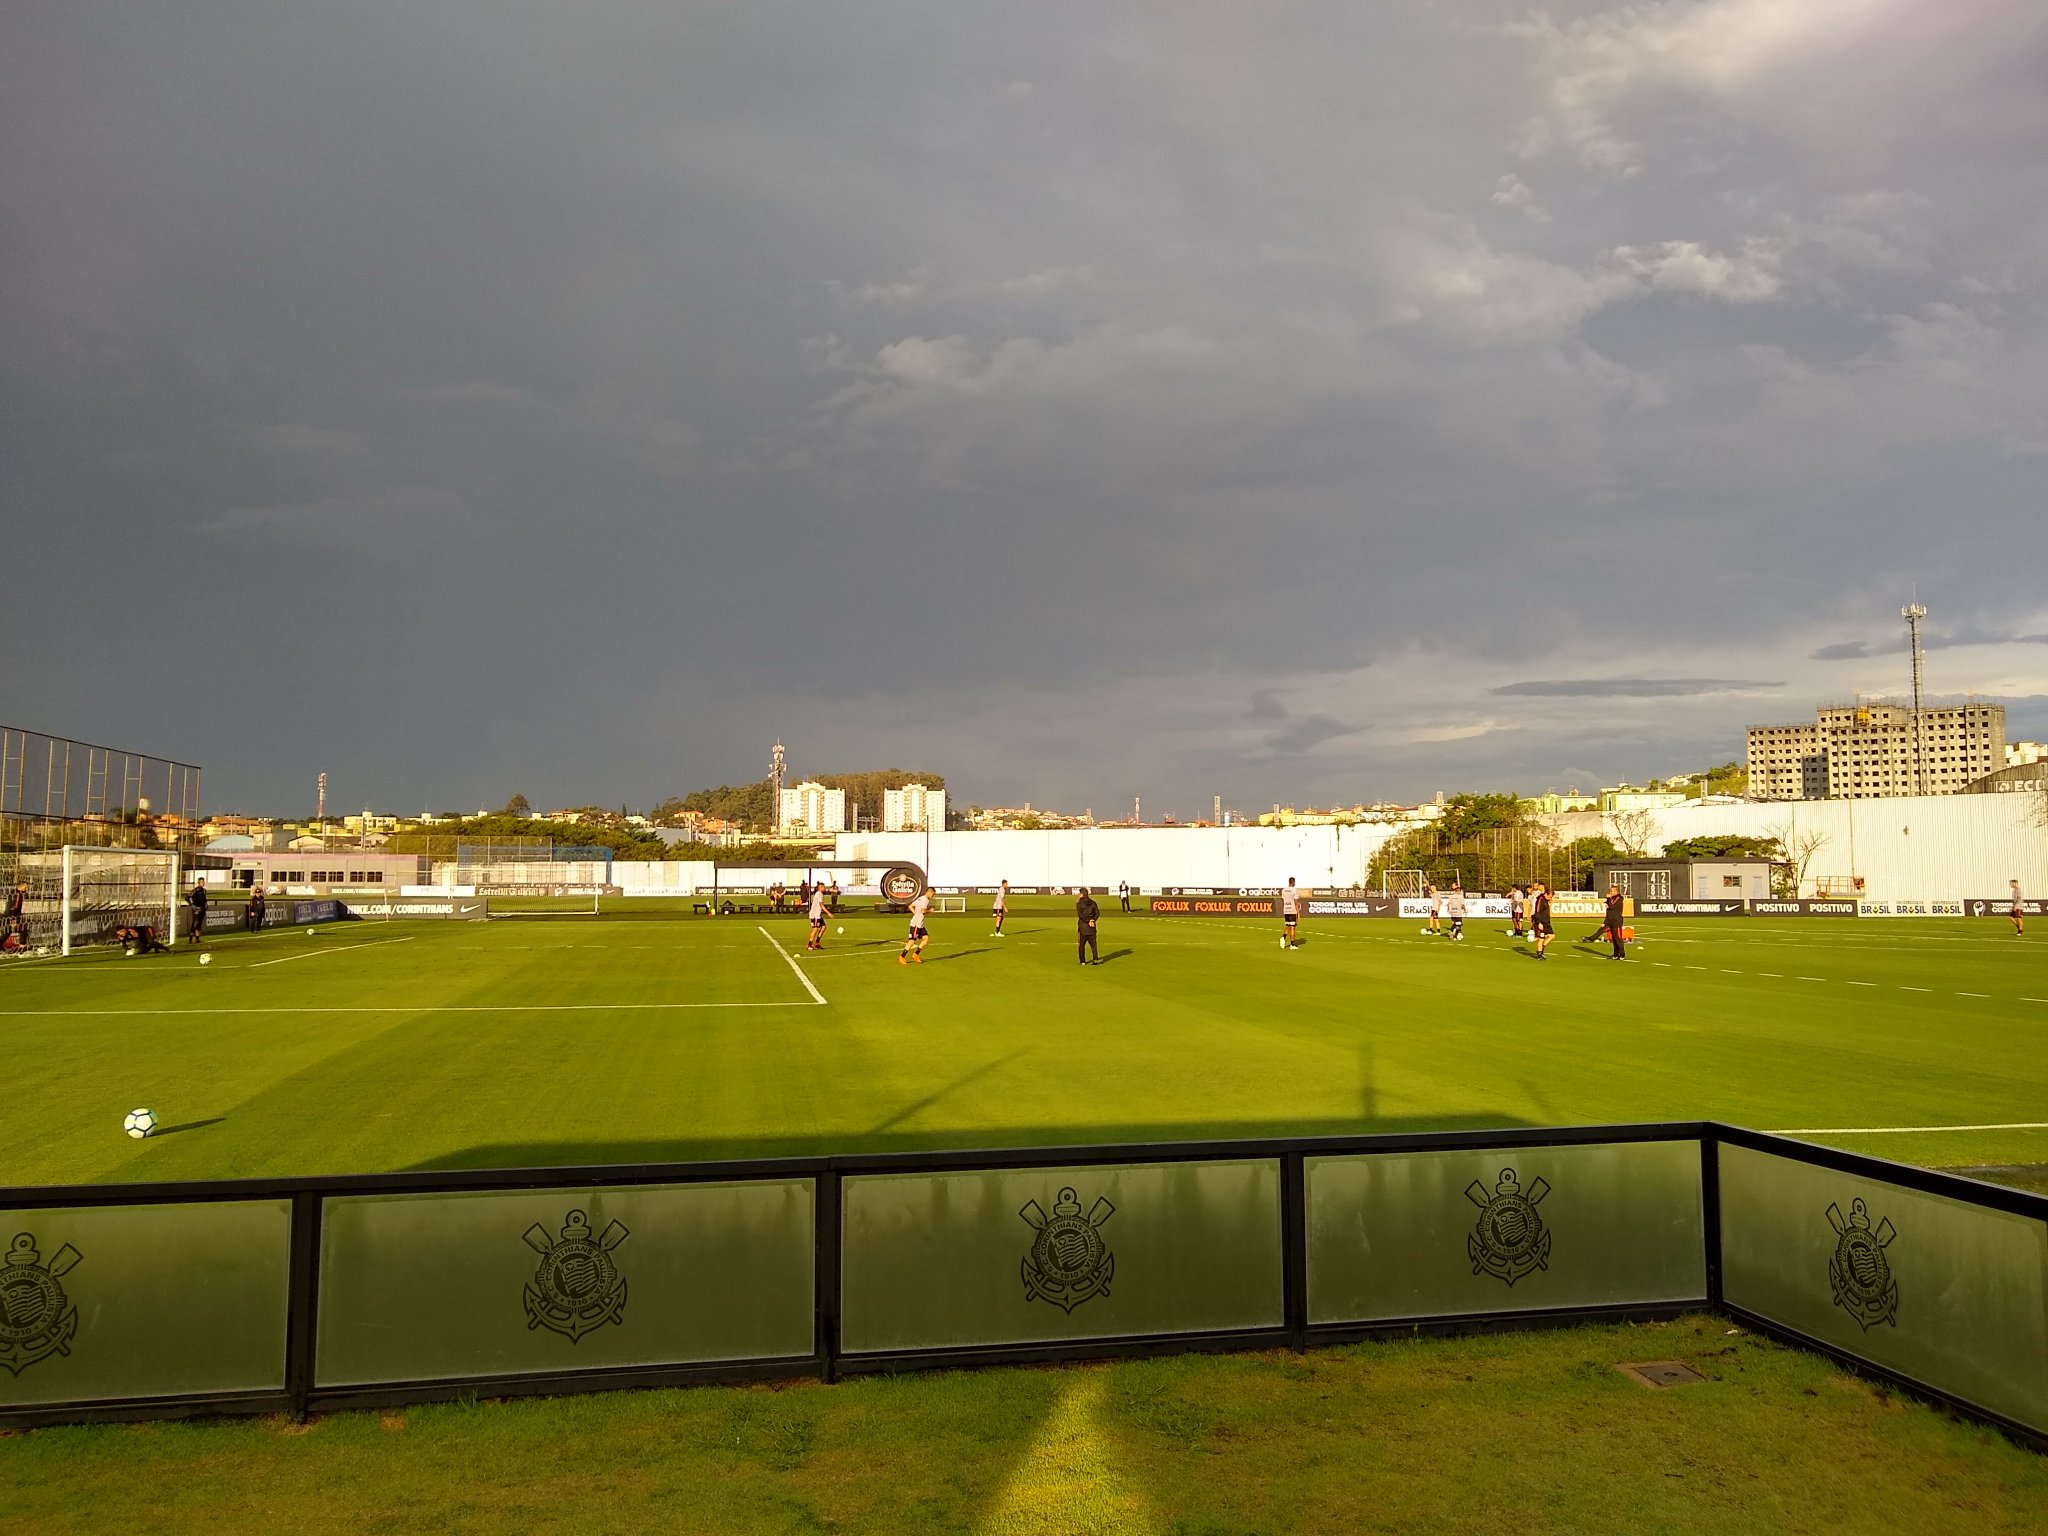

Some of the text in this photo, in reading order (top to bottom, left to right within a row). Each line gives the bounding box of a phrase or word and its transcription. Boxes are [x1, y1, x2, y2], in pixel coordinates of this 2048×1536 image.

[1623, 872, 1628, 884] 3
[1650, 872, 1656, 884] 4
[1661, 872, 1666, 884] 2
[1623, 884, 1666, 895] 7 8 6
[346, 904, 454, 915] NIKE.COM/CORINTHIANS
[1152, 901, 1190, 911] FOXLUX
[1195, 902, 1232, 912] FOXLUX
[1236, 902, 1273, 912] FOXLUX
[1403, 905, 1431, 914] BRASI
[1485, 905, 1511, 914] BRASI
[1550, 902, 1607, 914] GATORA
[1640, 903, 1720, 913] NIKE.COM/CORINTHIANS
[1756, 903, 1800, 913] POSITIVO
[1809, 903, 1853, 913] POSITIVO
[1485, 1200, 1522, 1231] CORINTHIANS
[1522, 1207, 1534, 1243] PAULISTA
[1041, 1221, 1083, 1256] CORINTHIANS
[1083, 1229, 1096, 1268] PAULISTA
[545, 1245, 593, 1281] CORINTHIANS
[593, 1252, 606, 1294] PAULISTA
[1060, 1271, 1079, 1279] 1910
[41, 1279, 54, 1323] PAULISTA
[9, 1327, 31, 1336] 1910
